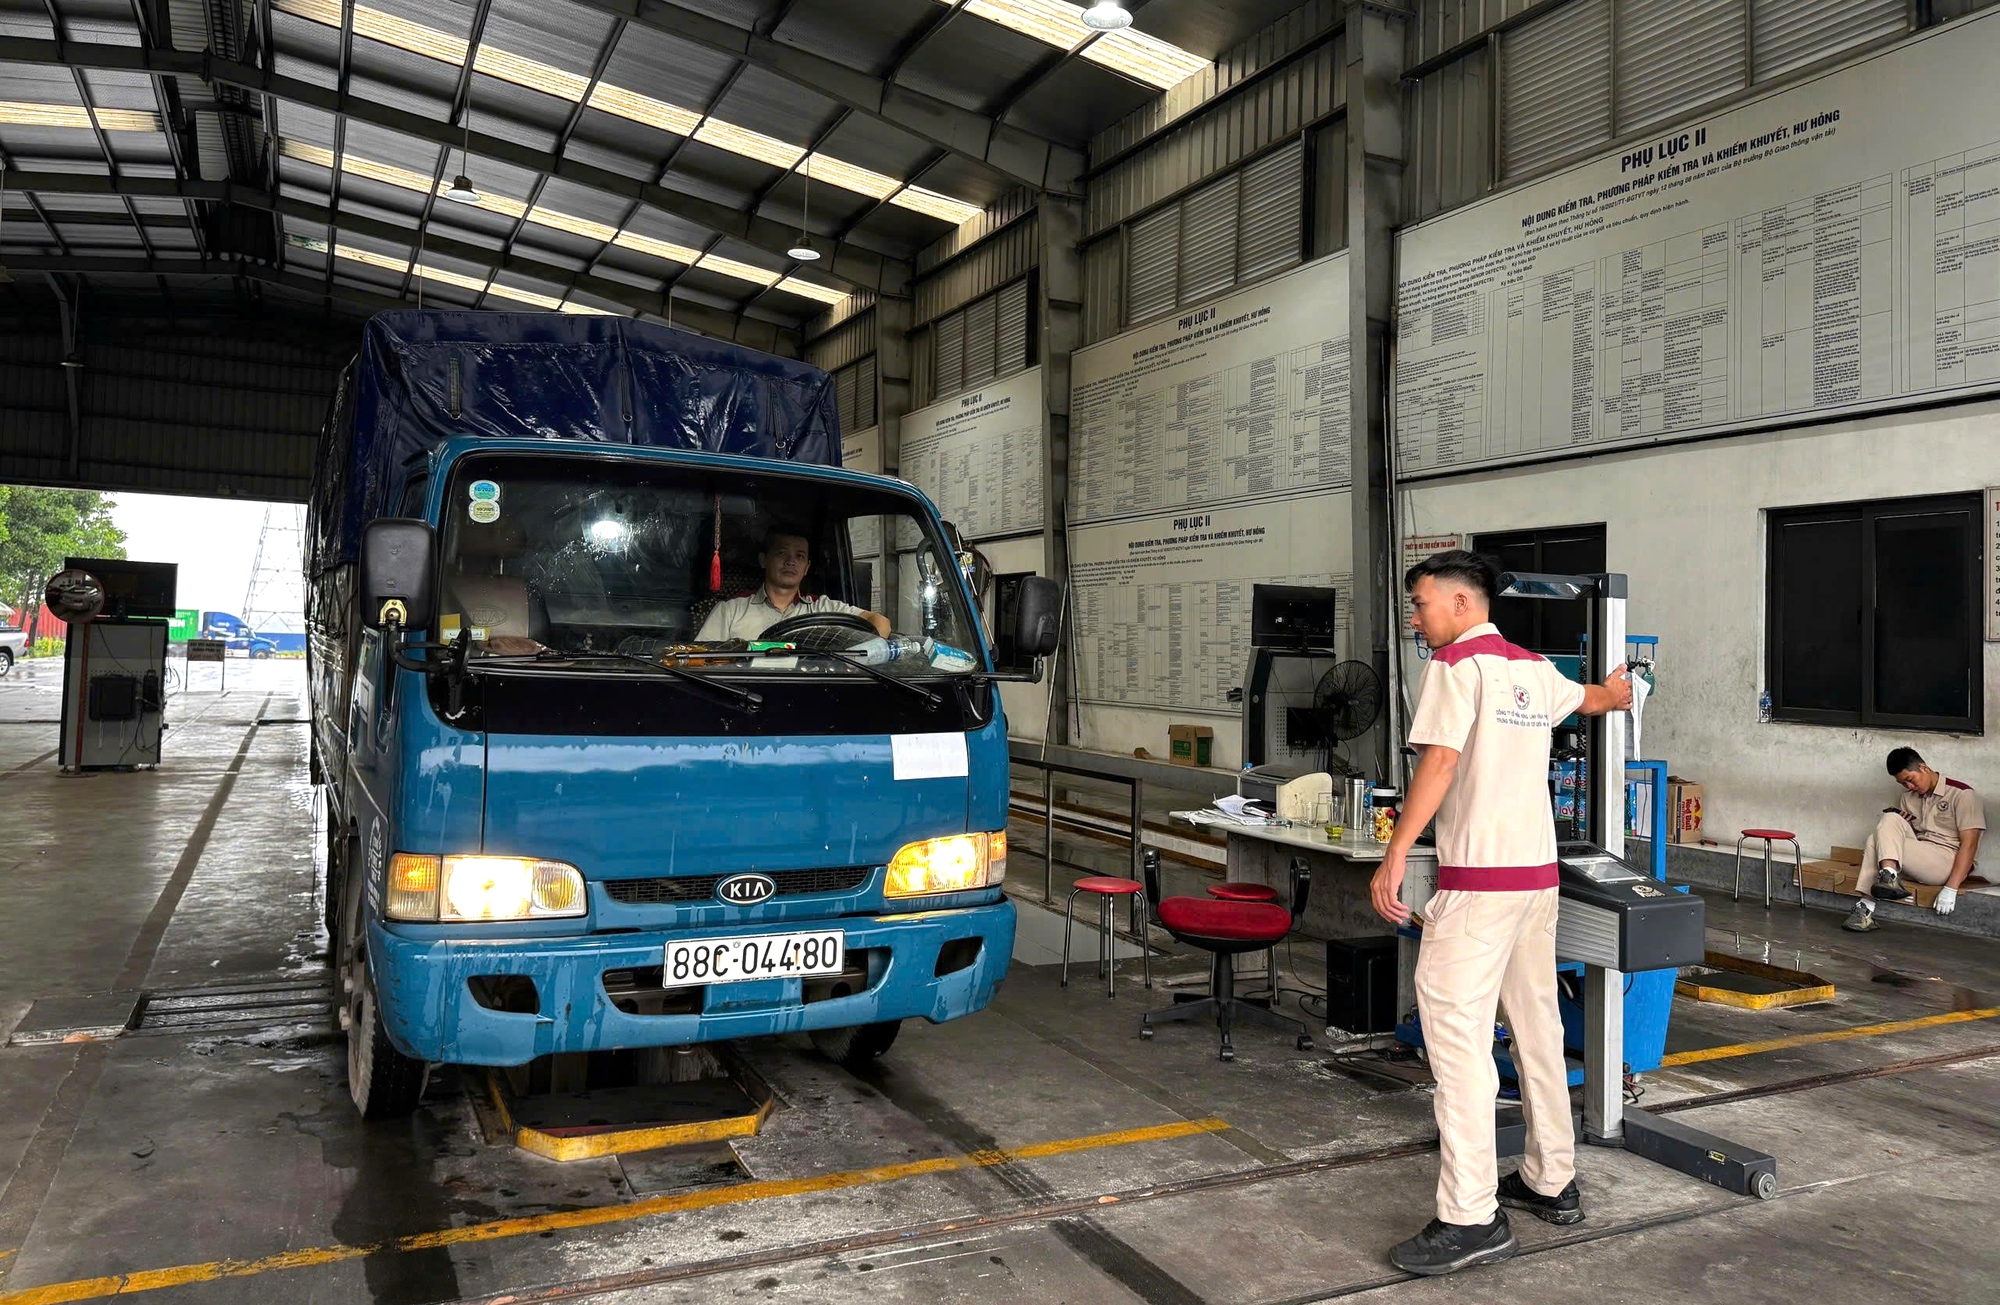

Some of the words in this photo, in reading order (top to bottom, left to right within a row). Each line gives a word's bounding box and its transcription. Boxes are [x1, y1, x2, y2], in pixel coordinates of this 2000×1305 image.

[1622, 147, 1653, 174] PHỤ
[1659, 134, 1690, 161] LỤC
[1696, 128, 1707, 148] II
[1521, 215, 1534, 227] NỘI
[1536, 208, 1556, 222] DUNG
[1557, 200, 1576, 215] KIỂM
[1579, 196, 1595, 208] TRA,
[1597, 183, 1630, 202] PHƯƠNG
[1632, 174, 1654, 190] PHÁP
[1658, 164, 1679, 181] KIỂM
[1682, 159, 1699, 173] TRA
[1702, 152, 1714, 166] VÀ
[1716, 141, 1747, 161] KHIẾM
[1750, 128, 1790, 150] KHUYẾT,
[1793, 121, 1808, 135] HƯ
[1810, 110, 1840, 130] HỎNG
[1178, 316, 1193, 330] PHỤ
[1194, 311, 1208, 325] LỤC
[1210, 308, 1216, 320] II
[1174, 518, 1188, 531] PHỤ
[1190, 517, 1203, 530] LỤC
[1205, 516, 1210, 526] II
[730, 882, 766, 898] KIA
